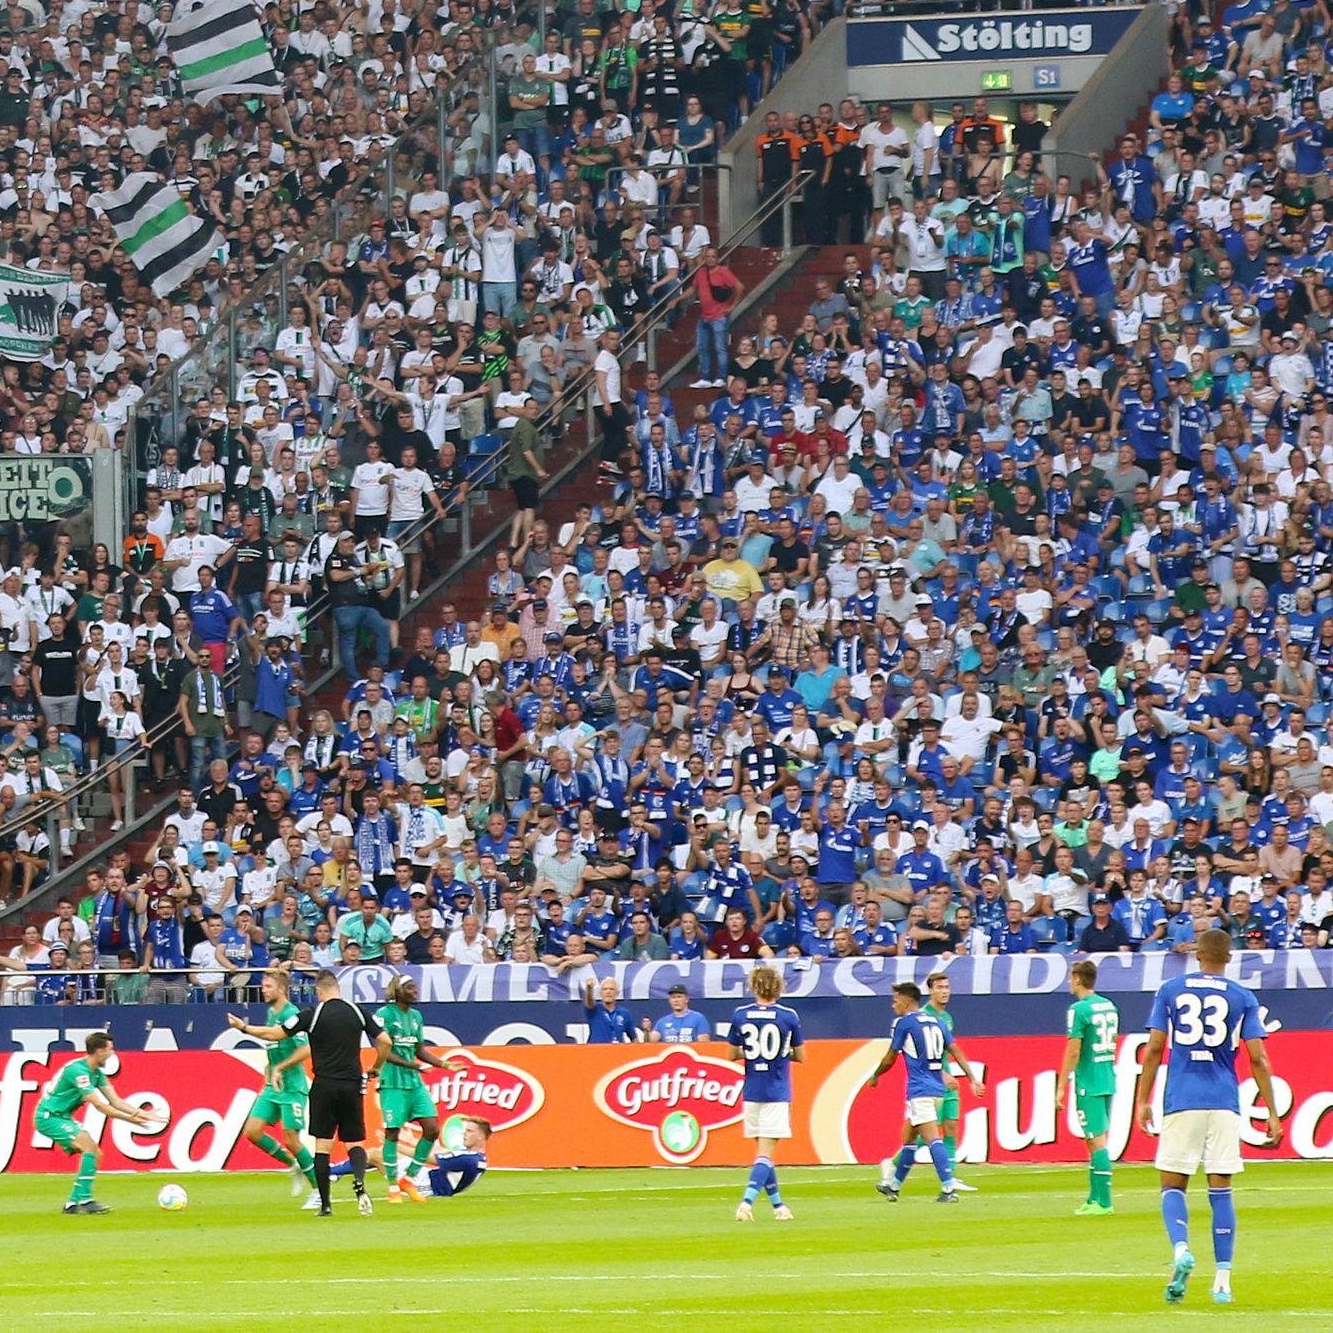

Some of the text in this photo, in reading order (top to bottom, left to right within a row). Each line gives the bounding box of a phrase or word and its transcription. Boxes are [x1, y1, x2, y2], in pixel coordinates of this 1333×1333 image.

[938, 21, 1092, 54] Stölting
[1039, 70, 1057, 85] S1
[1091, 1011, 1119, 1053] 32
[1174, 992, 1229, 1048] 33
[740, 1022, 781, 1061] 30
[921, 1025, 945, 1060] 10
[426, 1069, 524, 1111] utfried
[617, 1066, 745, 1116] Gutfried
